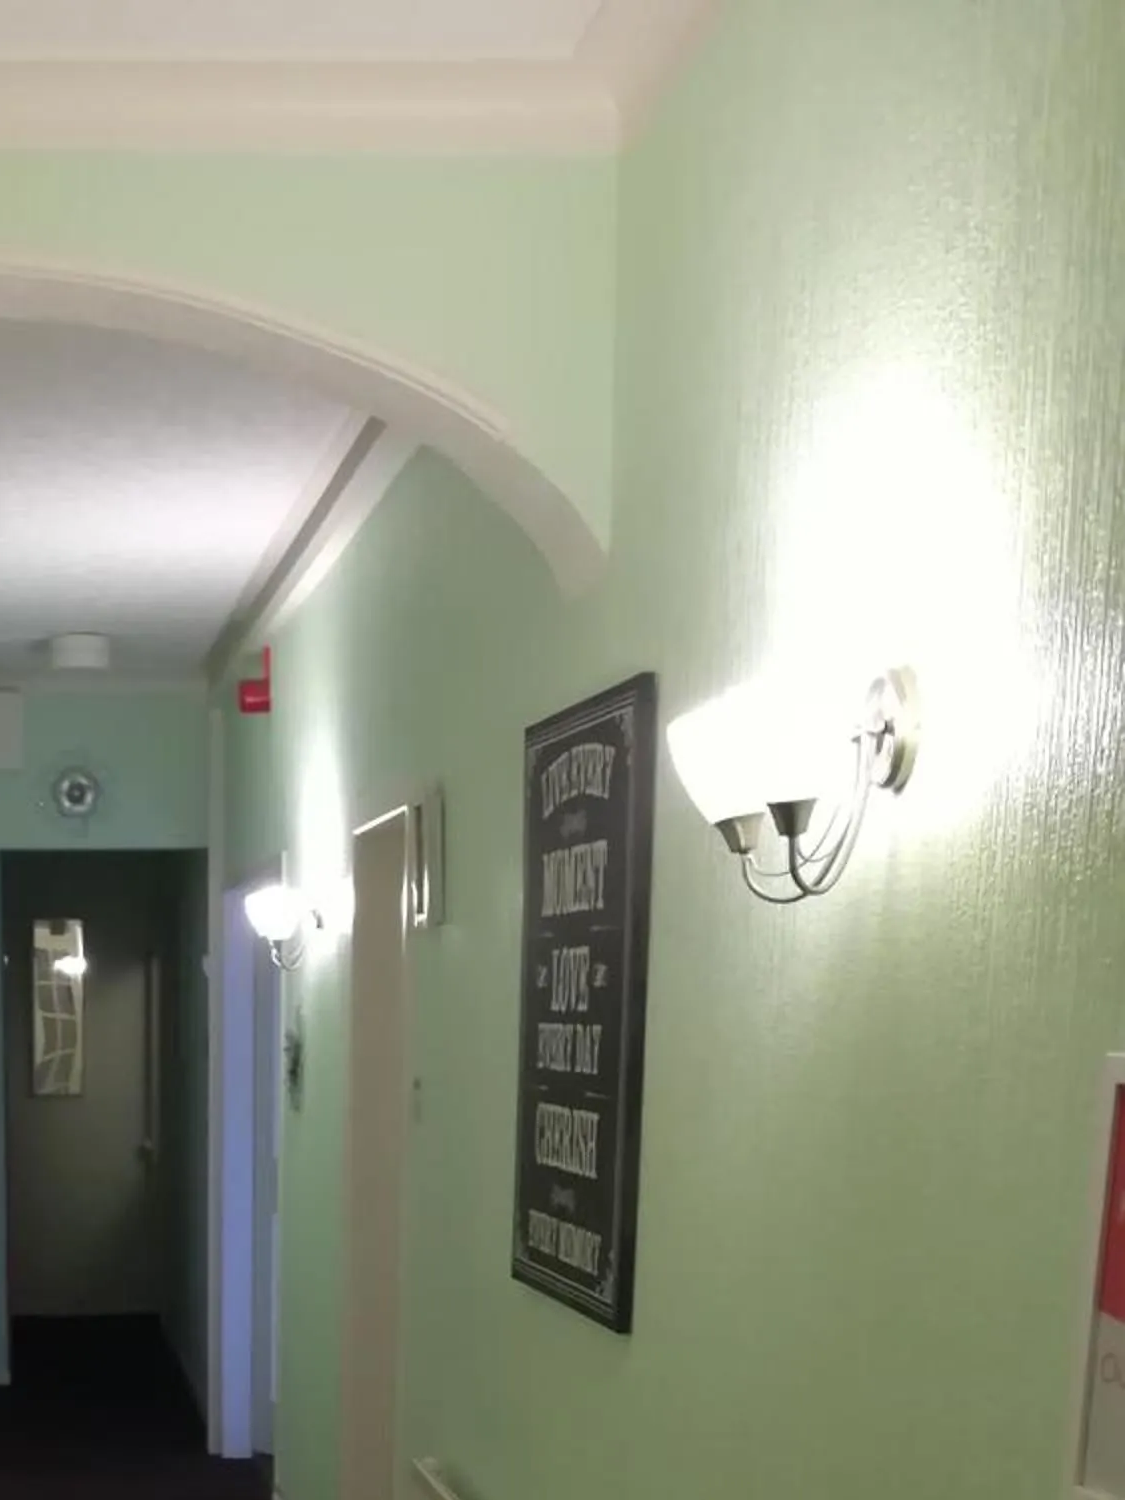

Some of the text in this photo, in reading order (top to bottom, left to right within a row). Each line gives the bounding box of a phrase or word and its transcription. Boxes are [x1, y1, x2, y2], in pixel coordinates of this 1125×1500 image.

[542, 743, 615, 819] LIVE EVERY
[542, 840, 608, 917] MOMENT
[551, 946, 589, 1011] LOVE
[537, 1024, 602, 1073] EVERY DAY
[536, 1103, 599, 1178] CHERISH
